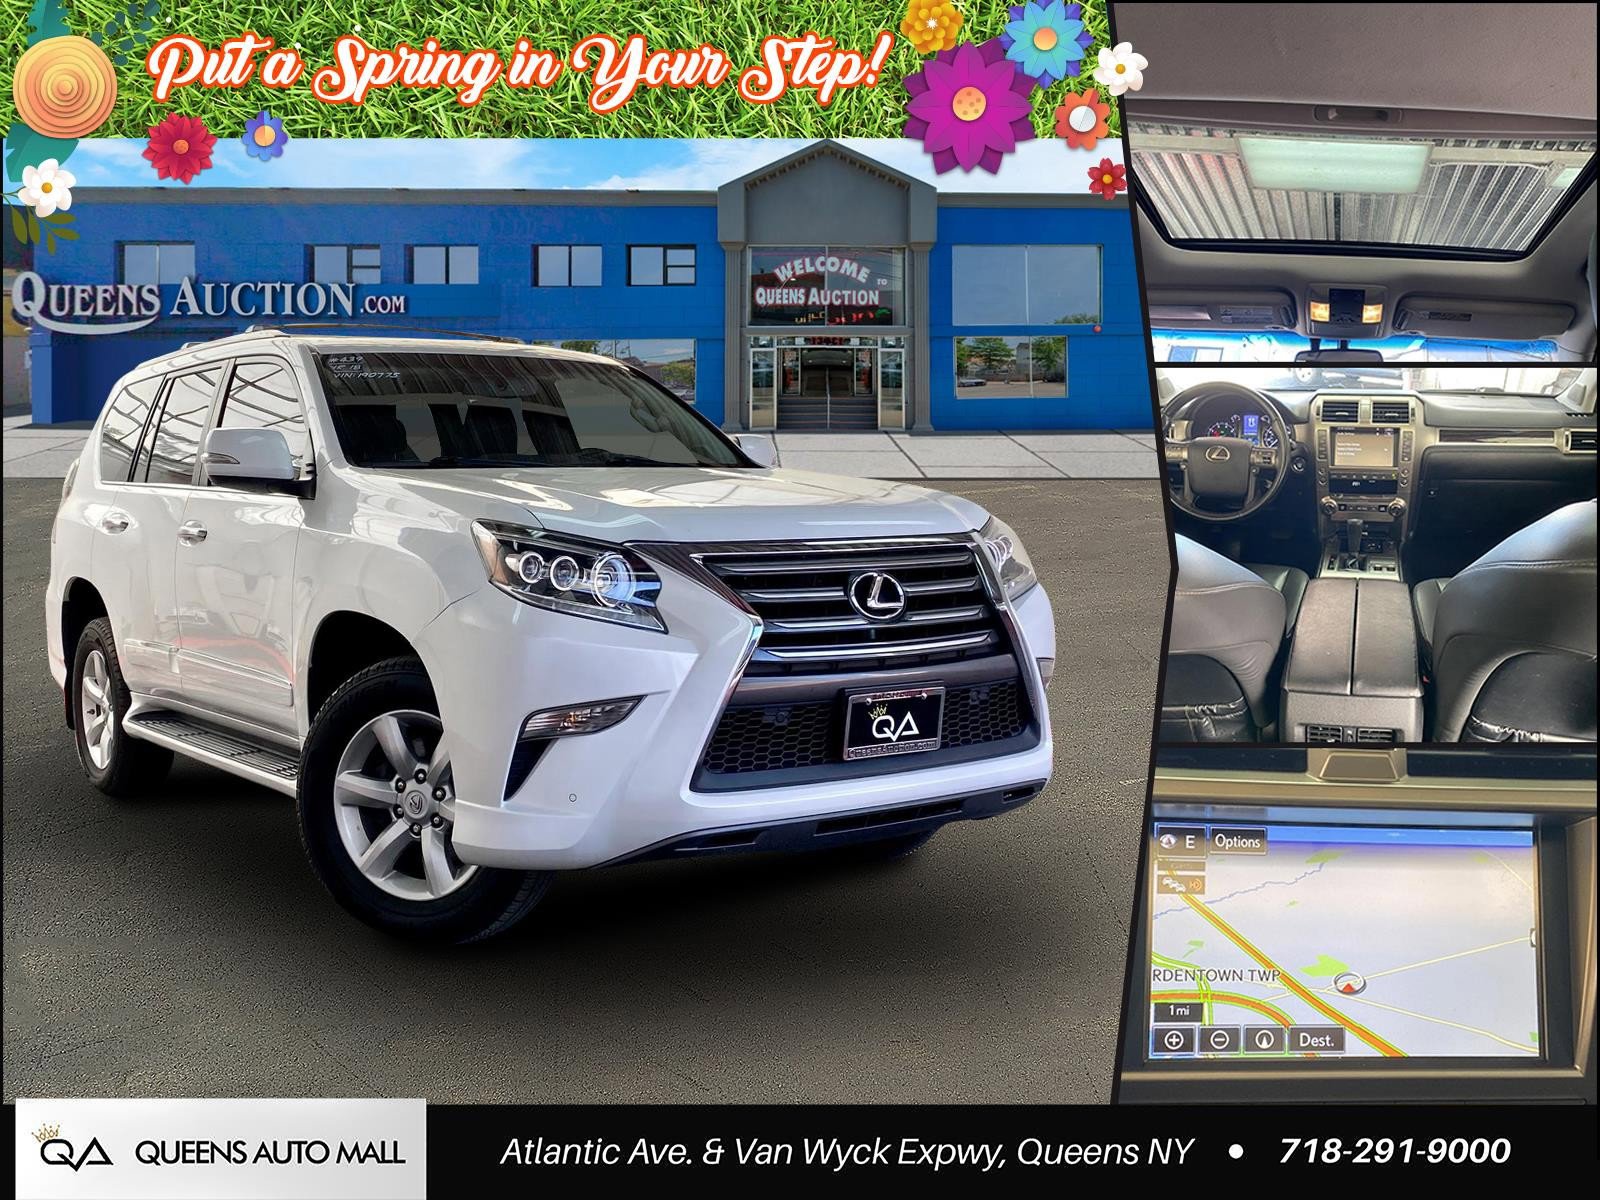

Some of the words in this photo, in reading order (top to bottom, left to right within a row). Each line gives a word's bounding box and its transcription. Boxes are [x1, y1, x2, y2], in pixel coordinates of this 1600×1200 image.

[773, 255, 871, 283] WELCOME
[876, 278, 888, 286] TO
[11, 271, 162, 336] QUEENS
[169, 276, 357, 317] AUCTION
[754, 286, 806, 306] QUEENS
[807, 287, 880, 306] AUCTION
[1185, 834, 1196, 850] E
[1215, 833, 1261, 850] Options
[1152, 968, 1244, 983] RDENTOWN
[1249, 968, 1281, 983] TWP
[1168, 1004, 1175, 1016] 1
[1176, 1004, 1190, 1016] mi
[1299, 1031, 1335, 1048] Dest.
